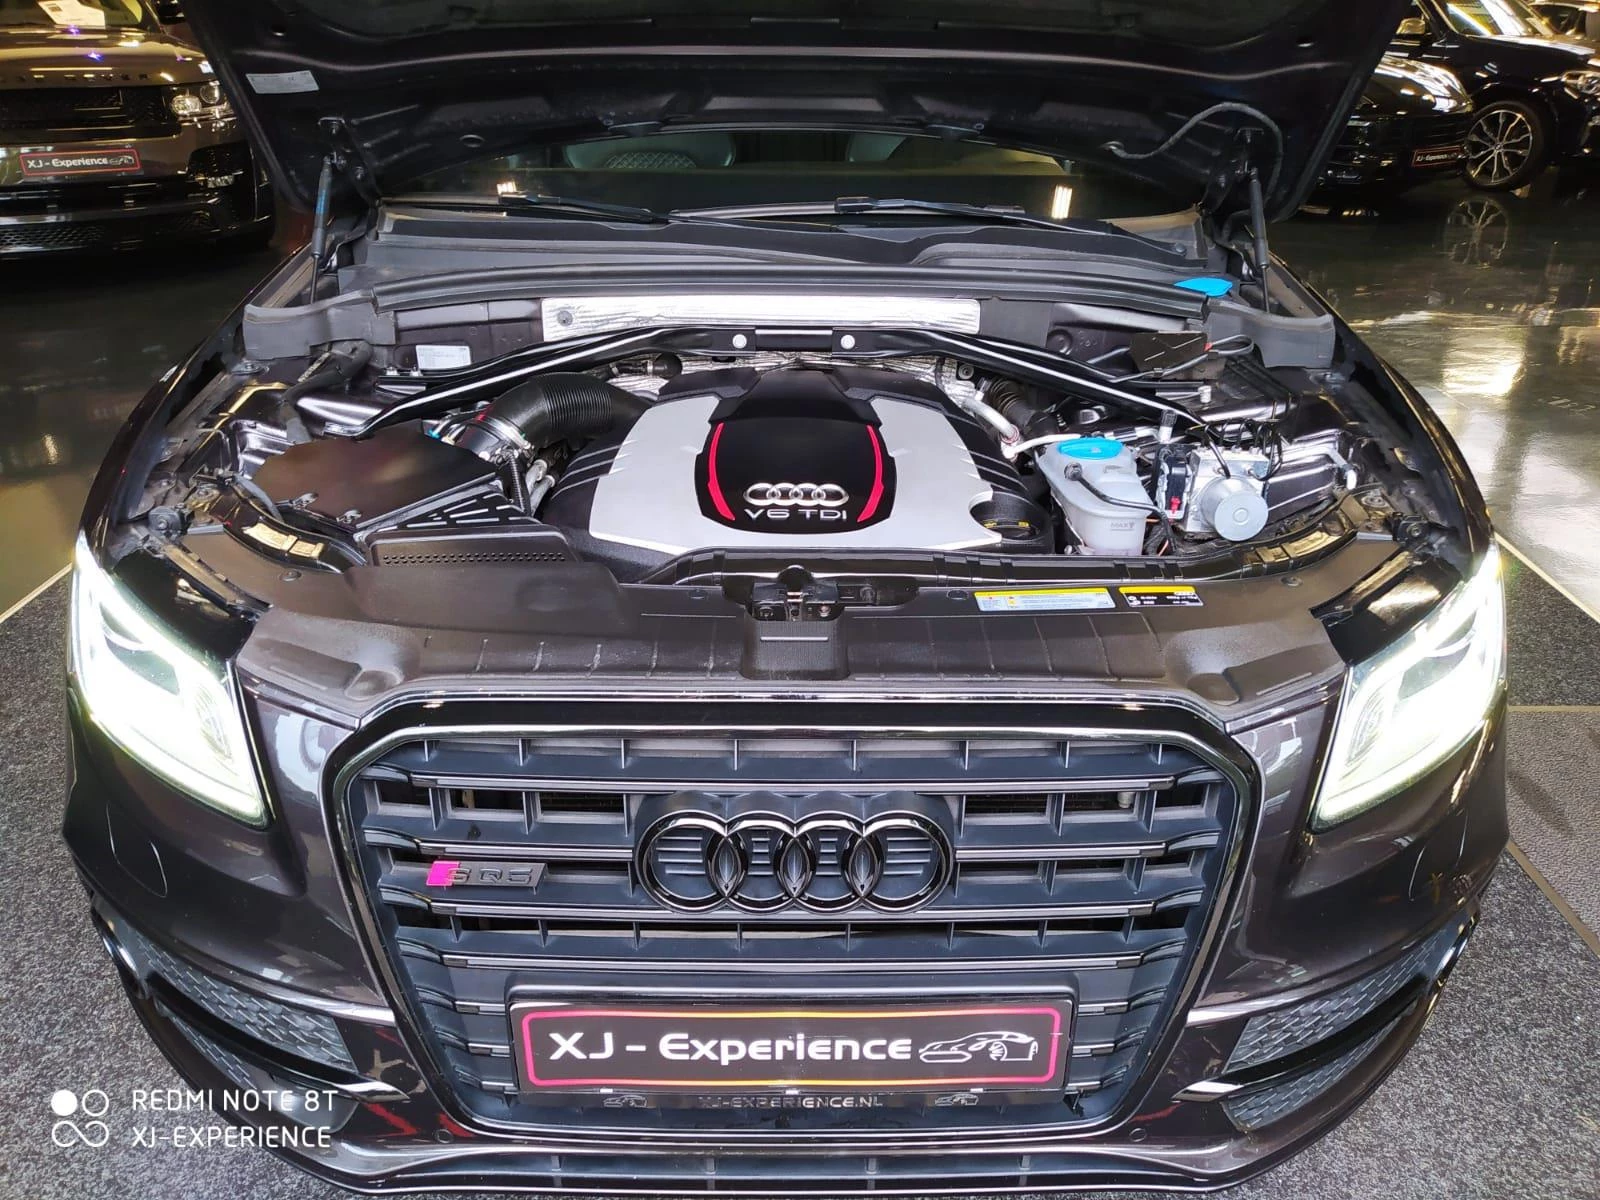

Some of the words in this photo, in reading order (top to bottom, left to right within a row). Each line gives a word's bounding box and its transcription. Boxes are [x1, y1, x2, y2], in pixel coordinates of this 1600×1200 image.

[27, 159, 43, 169] XJ
[51, 157, 109, 168] Experience
[744, 508, 790, 520] V6
[797, 509, 847, 520] TDI
[447, 868, 533, 884] SQ5
[549, 1032, 615, 1061] XJ
[658, 1033, 912, 1066] Experience
[699, 1095, 884, 1109] XJ-EXPERIENCE.NL
